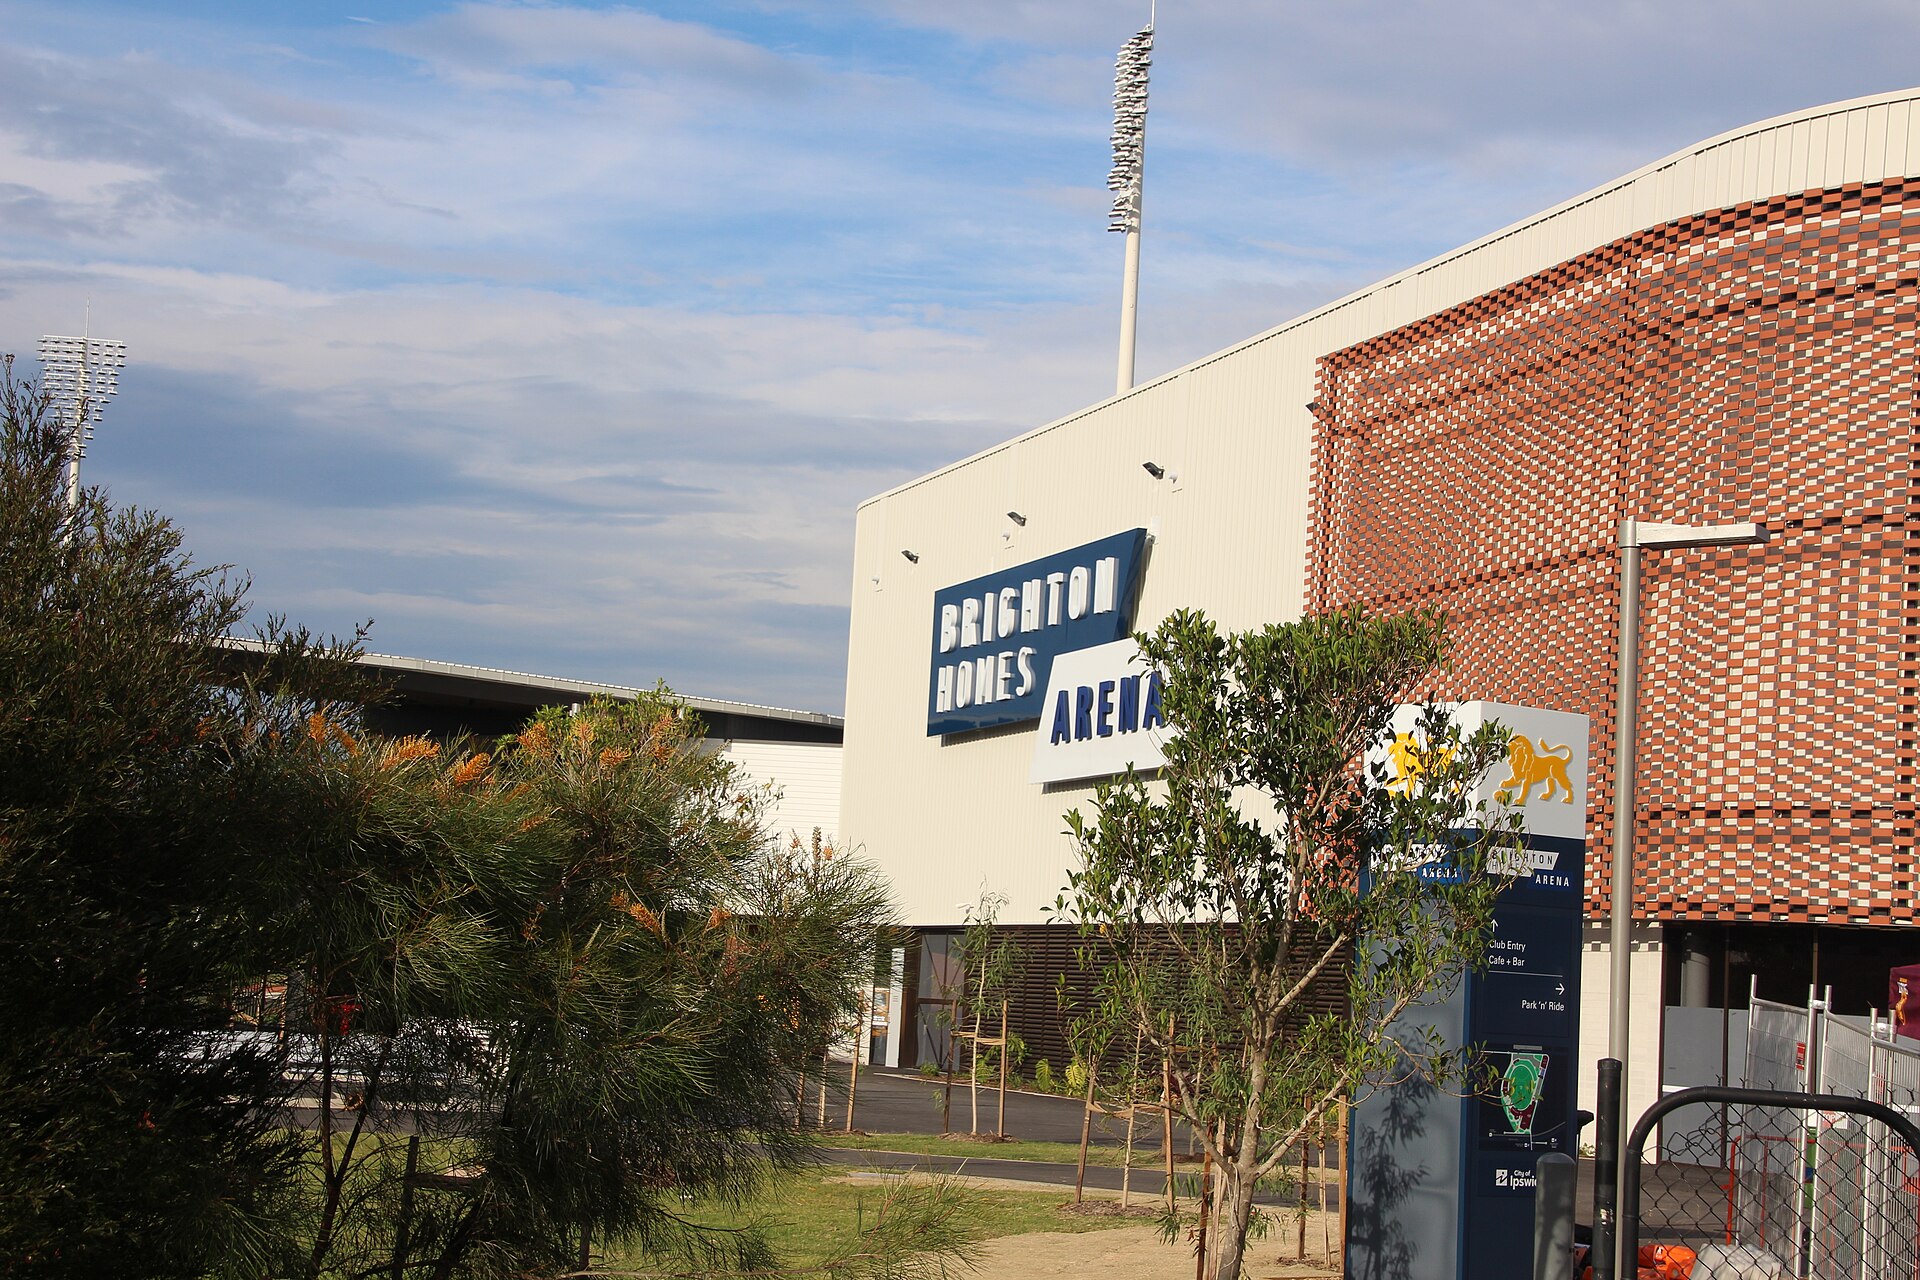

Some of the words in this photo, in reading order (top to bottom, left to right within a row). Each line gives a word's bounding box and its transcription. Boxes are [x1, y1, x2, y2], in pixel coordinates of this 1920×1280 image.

[939, 556, 1120, 653] BRIGHTON
[936, 646, 1037, 713] HOMES
[1050, 671, 1166, 746] ARENA
[1535, 874, 1570, 887] ARENA
[1507, 940, 1526, 953] Entry
[1488, 954, 1505, 965] Cafe
[1512, 956, 1525, 967] Bar
[1521, 999, 1537, 1010] Park
[1548, 1001, 1565, 1012] Ride
